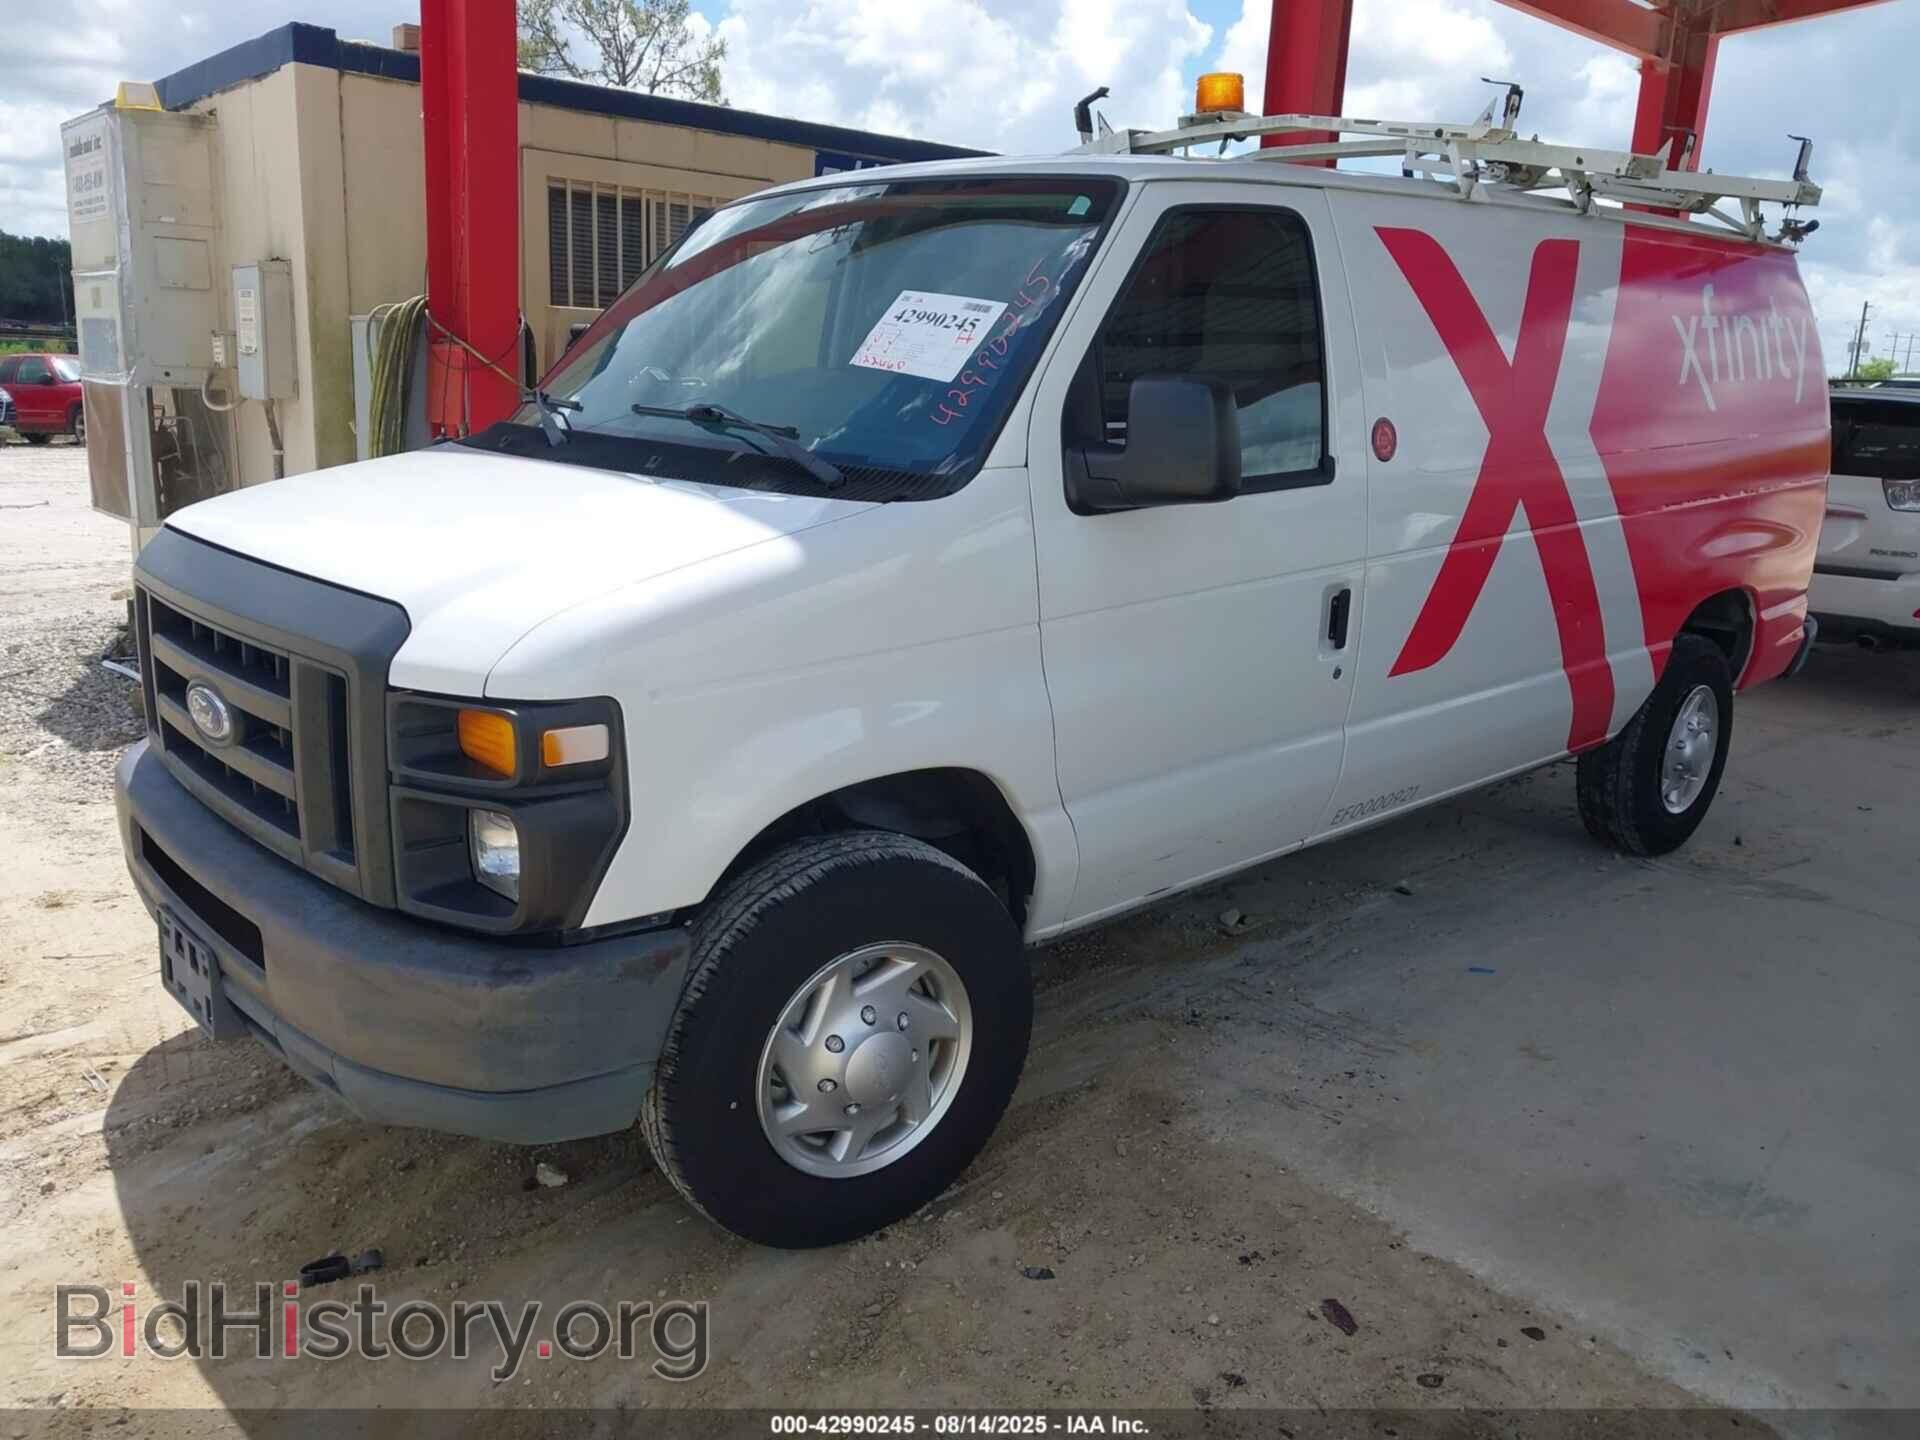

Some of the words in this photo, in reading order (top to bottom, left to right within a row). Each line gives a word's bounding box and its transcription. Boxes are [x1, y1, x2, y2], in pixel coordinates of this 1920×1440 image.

[893, 309, 981, 333] 42990245
[929, 257, 1049, 425] 42990245
[1671, 283, 1808, 412] xfinity
